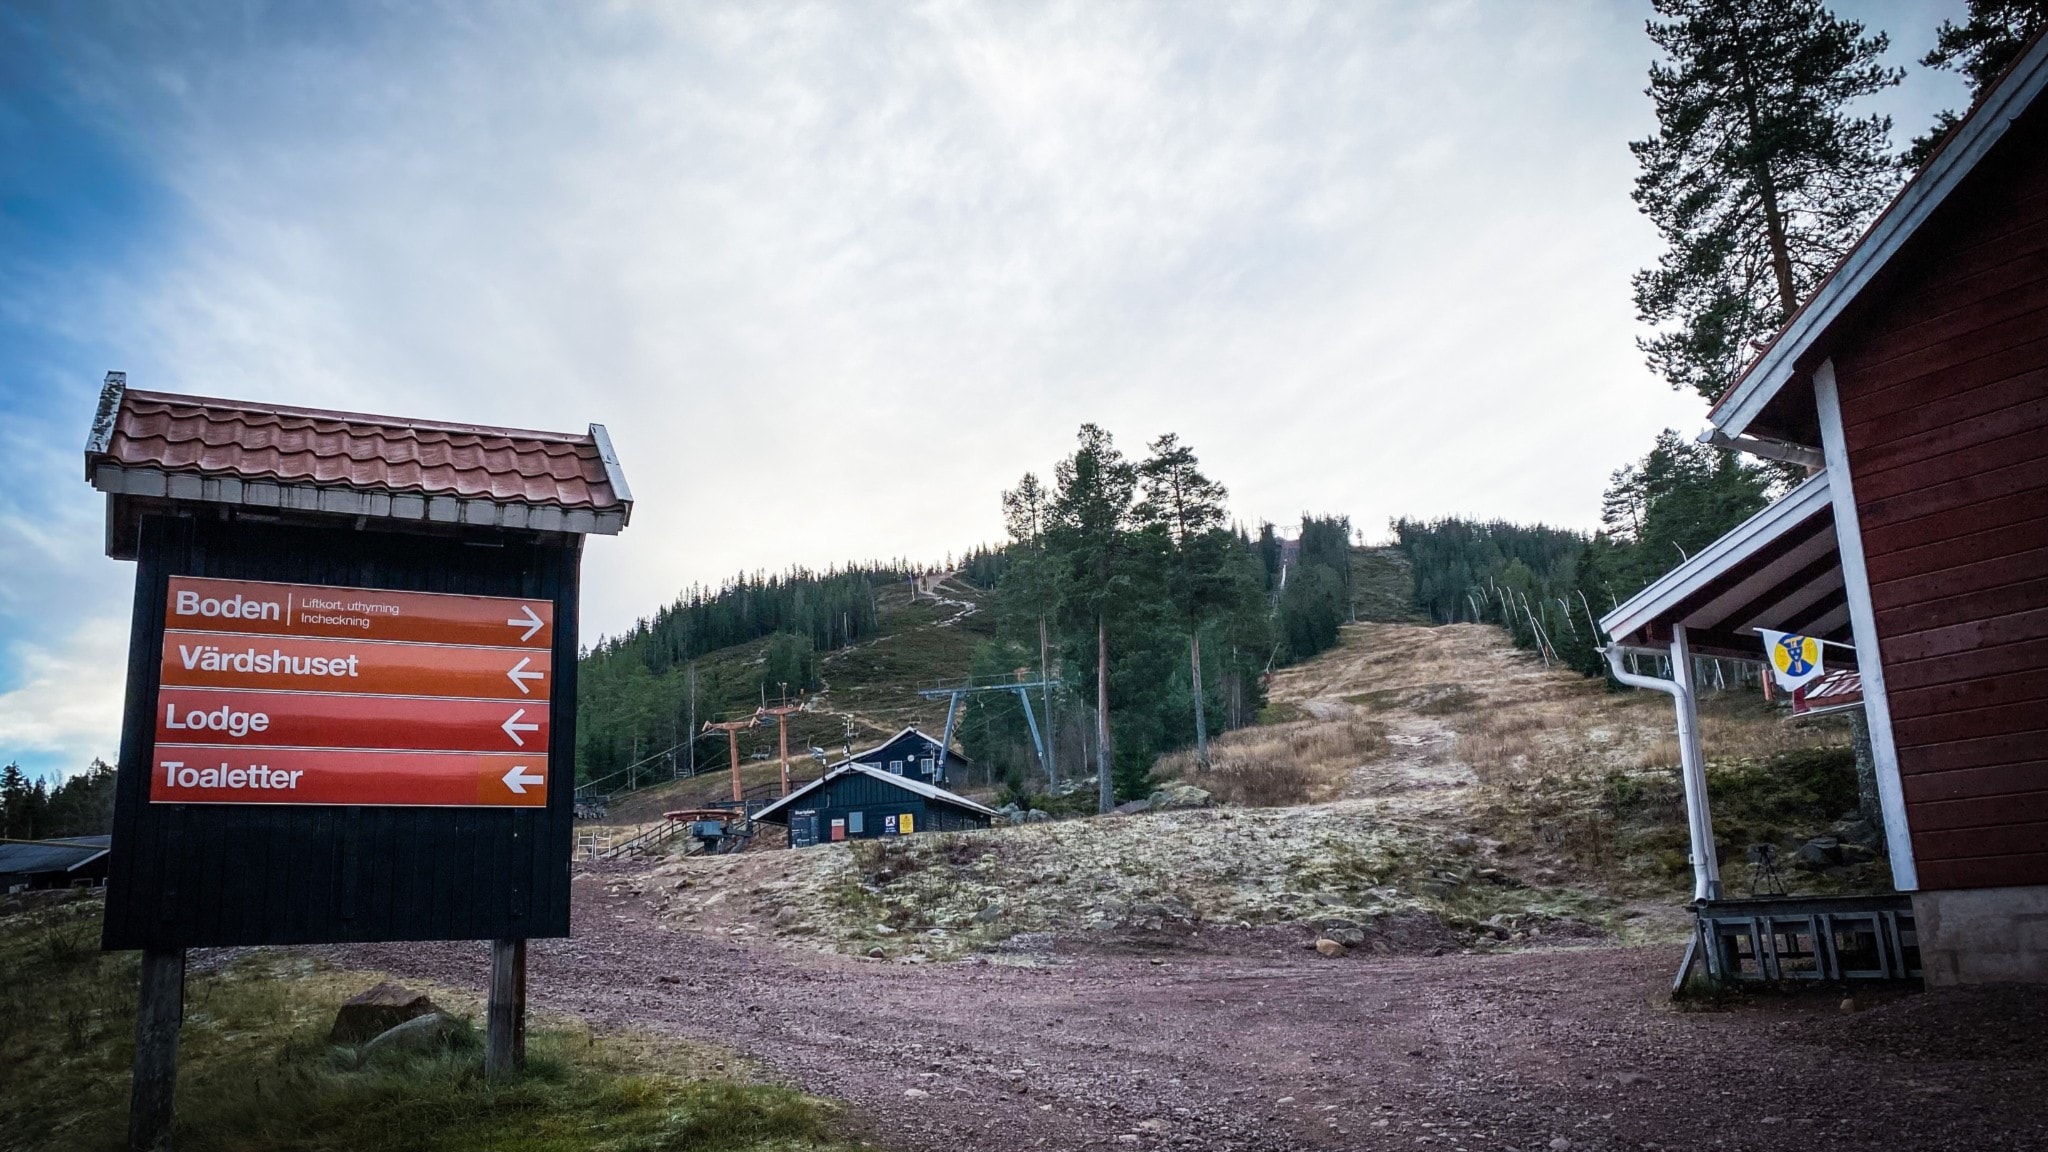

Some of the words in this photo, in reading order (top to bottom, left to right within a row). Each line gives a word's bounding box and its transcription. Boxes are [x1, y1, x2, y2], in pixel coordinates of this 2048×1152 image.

[176, 591, 280, 621] Boden
[302, 598, 344, 611] Liftkort,
[347, 601, 400, 616] uthyrning
[301, 613, 370, 629] Incheckning
[179, 645, 359, 677] Värdshuset
[166, 704, 270, 736] Lodge
[161, 761, 303, 789] Toaletter
